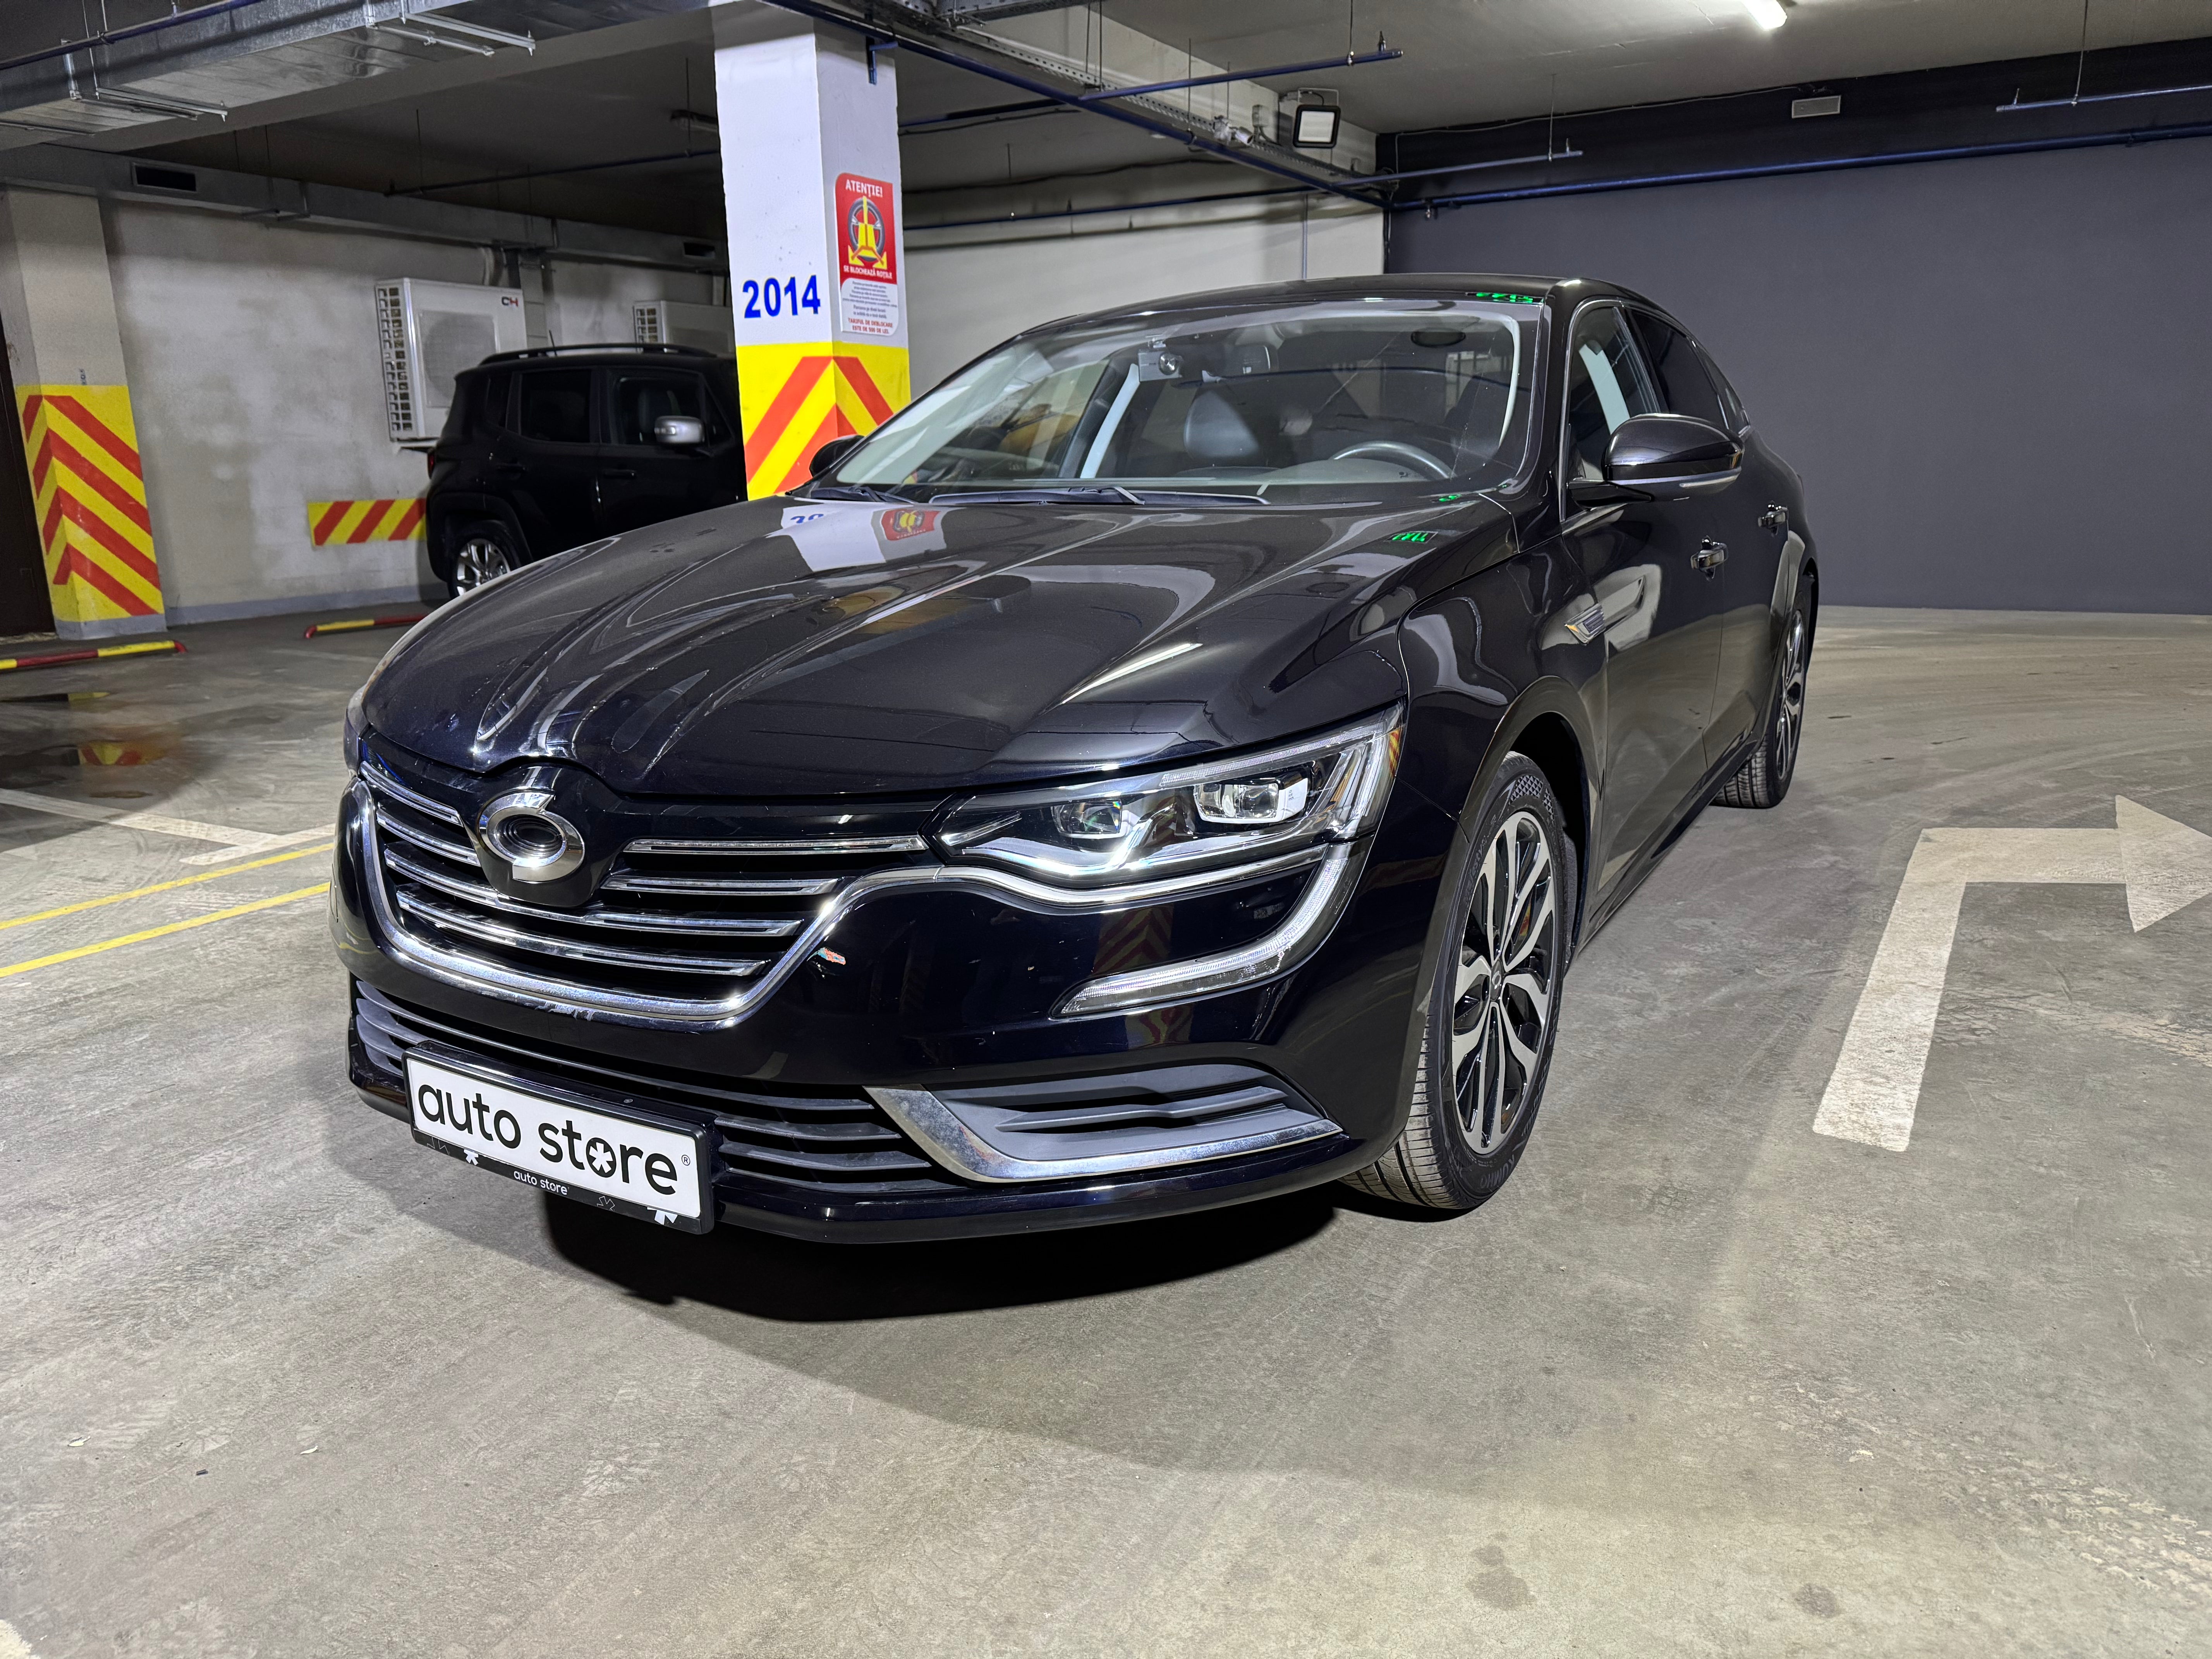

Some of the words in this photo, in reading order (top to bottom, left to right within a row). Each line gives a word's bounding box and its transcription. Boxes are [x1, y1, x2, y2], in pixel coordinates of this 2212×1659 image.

[501, 296, 519, 307] CH
[742, 275, 821, 318] 2014
[418, 1084, 521, 1149] auto
[514, 1171, 538, 1185] auto
[540, 1179, 568, 1195] store
